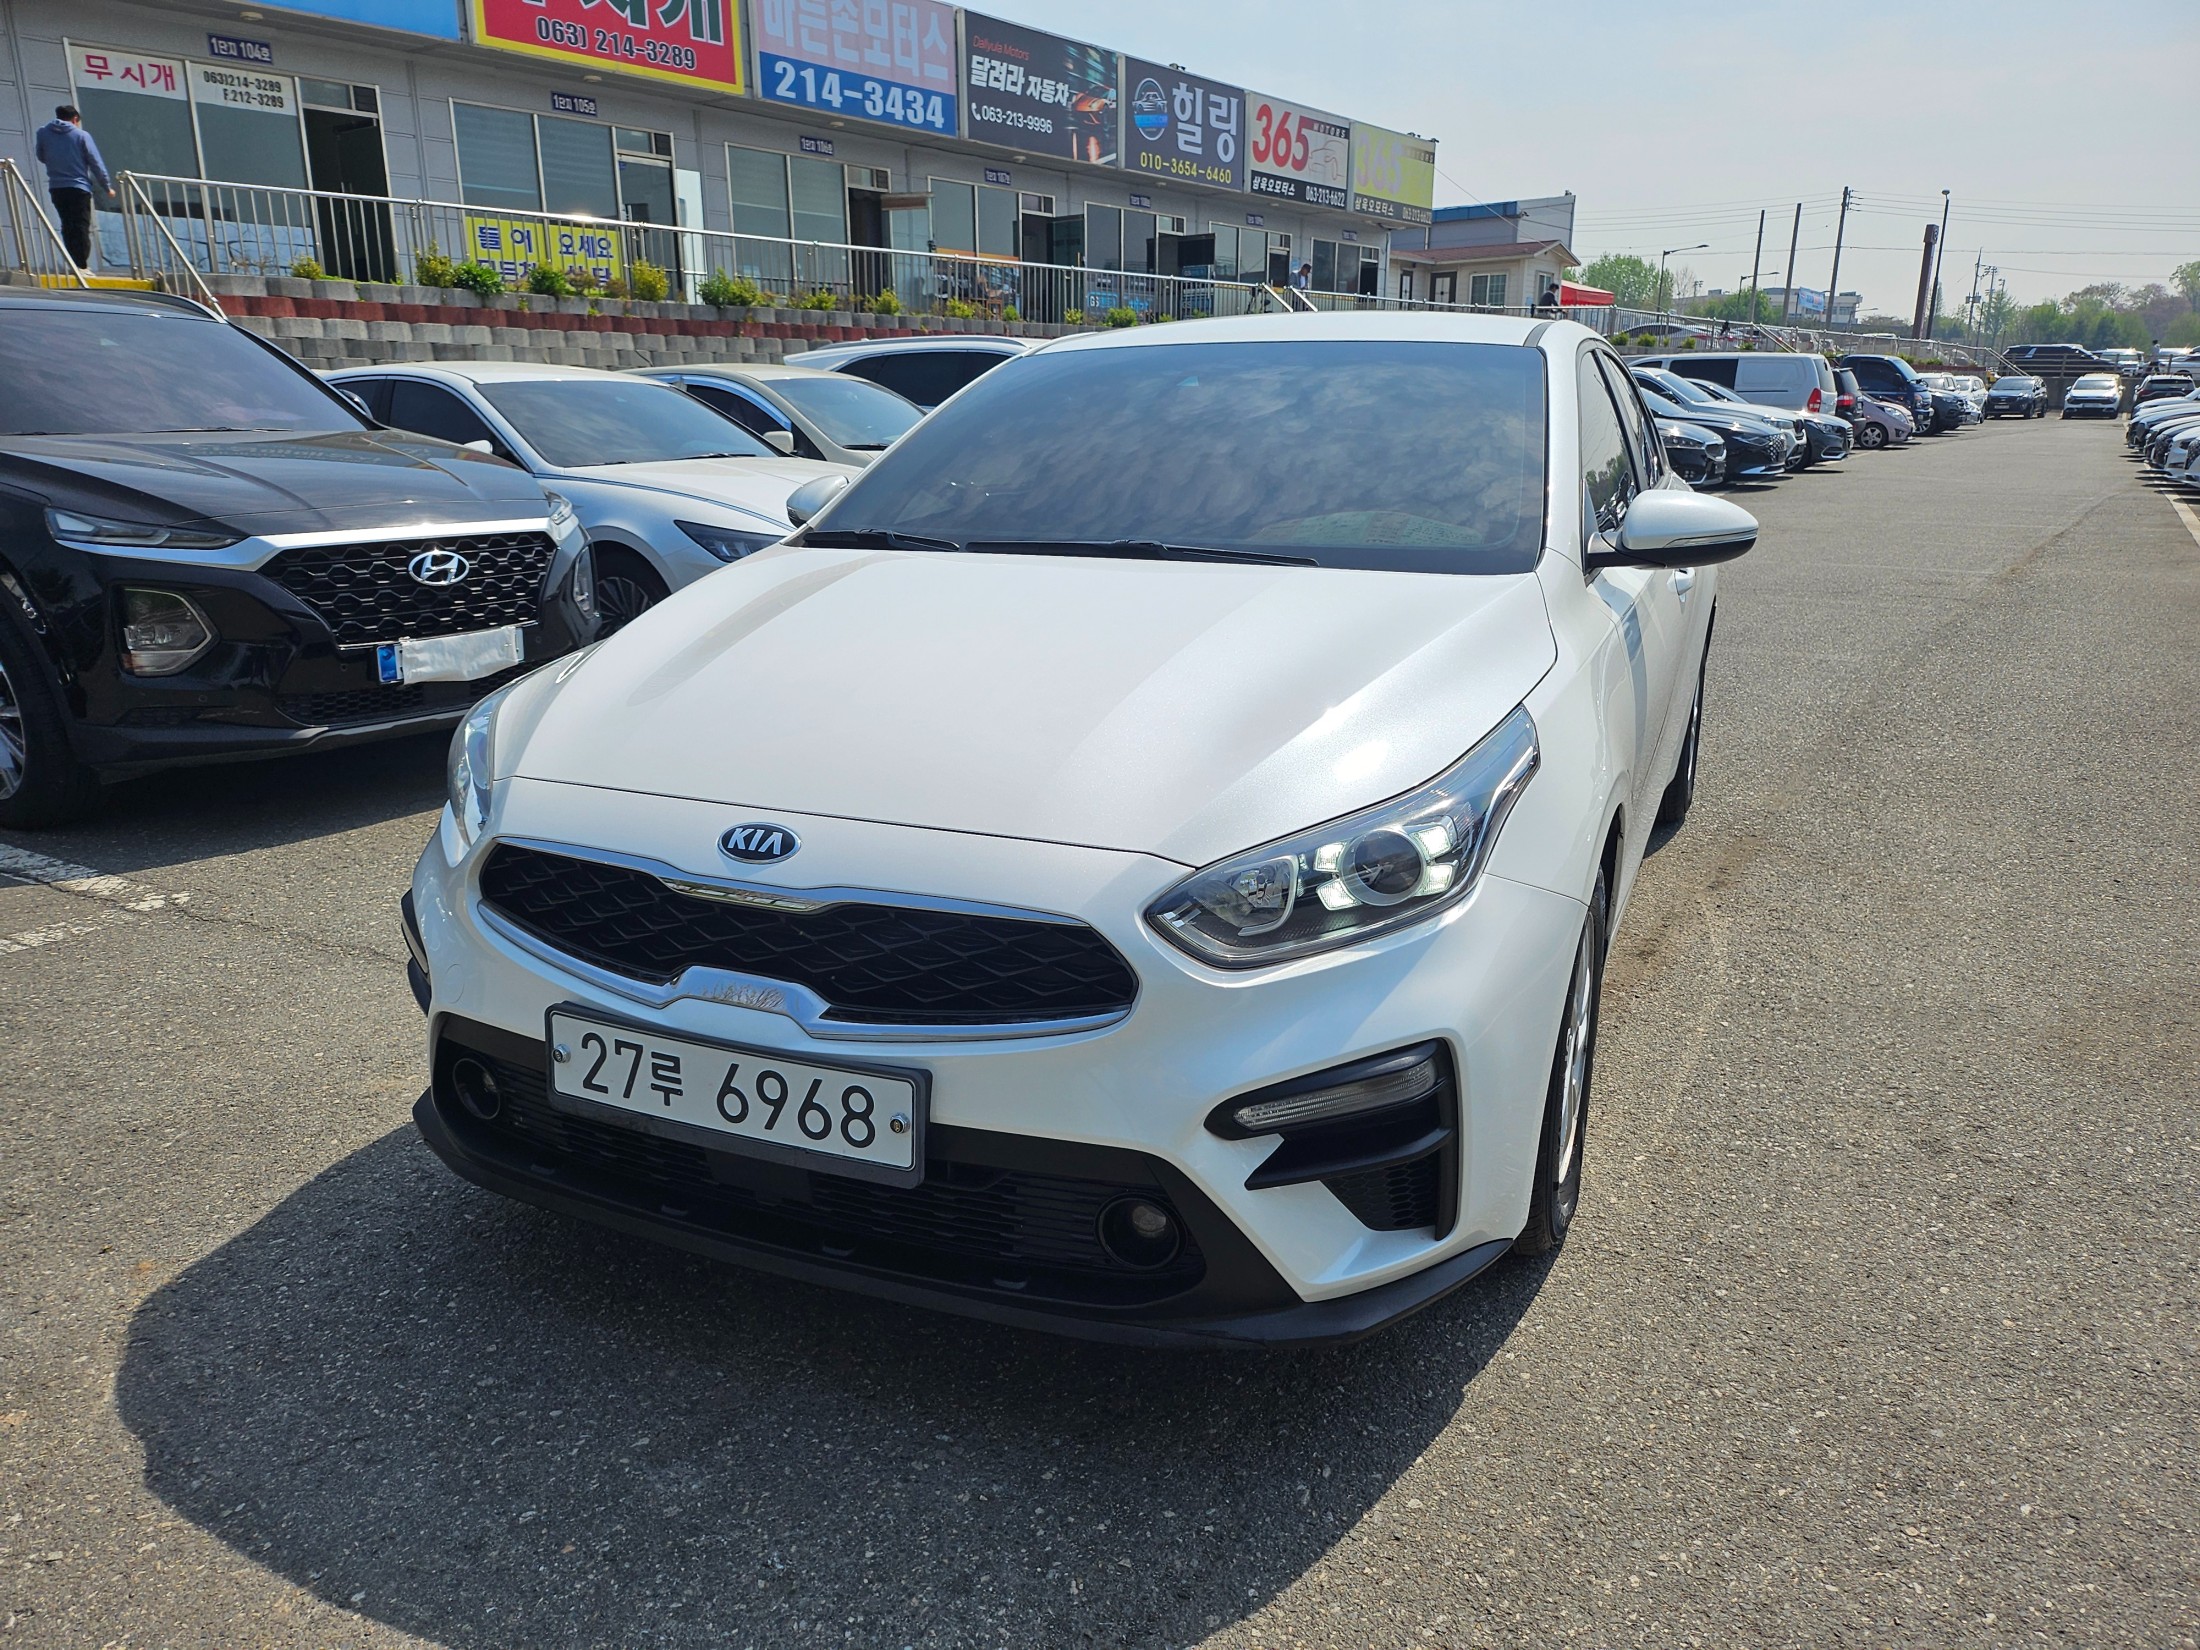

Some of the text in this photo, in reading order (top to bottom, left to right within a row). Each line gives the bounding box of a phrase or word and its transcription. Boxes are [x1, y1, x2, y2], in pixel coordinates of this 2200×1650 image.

[210, 37, 272, 62] 1단지 104호
[536, 16, 587, 49] 063)
[594, 29, 697, 70] 214-3289
[774, 60, 945, 129] 214-3434
[970, 54, 1070, 107] 달려라 자동차
[223, 88, 284, 108] F.212-3289
[981, 105, 1053, 134] 063-213-9996
[1172, 82, 1239, 163] 힐링
[1313, 122, 1346, 138] MOTORS
[1252, 103, 1309, 172] 365
[1140, 151, 1232, 184] 010-3654-6460
[1355, 130, 1402, 195] 365
[1252, 175, 1296, 196] 삼육오모터스
[1305, 185, 1345, 208] 063-213-6622
[1354, 196, 1395, 216] 삼육오모터스
[559, 232, 614, 259] 오세요
[727, 828, 782, 856] KIA
[581, 1032, 876, 1149] 27루 6968
